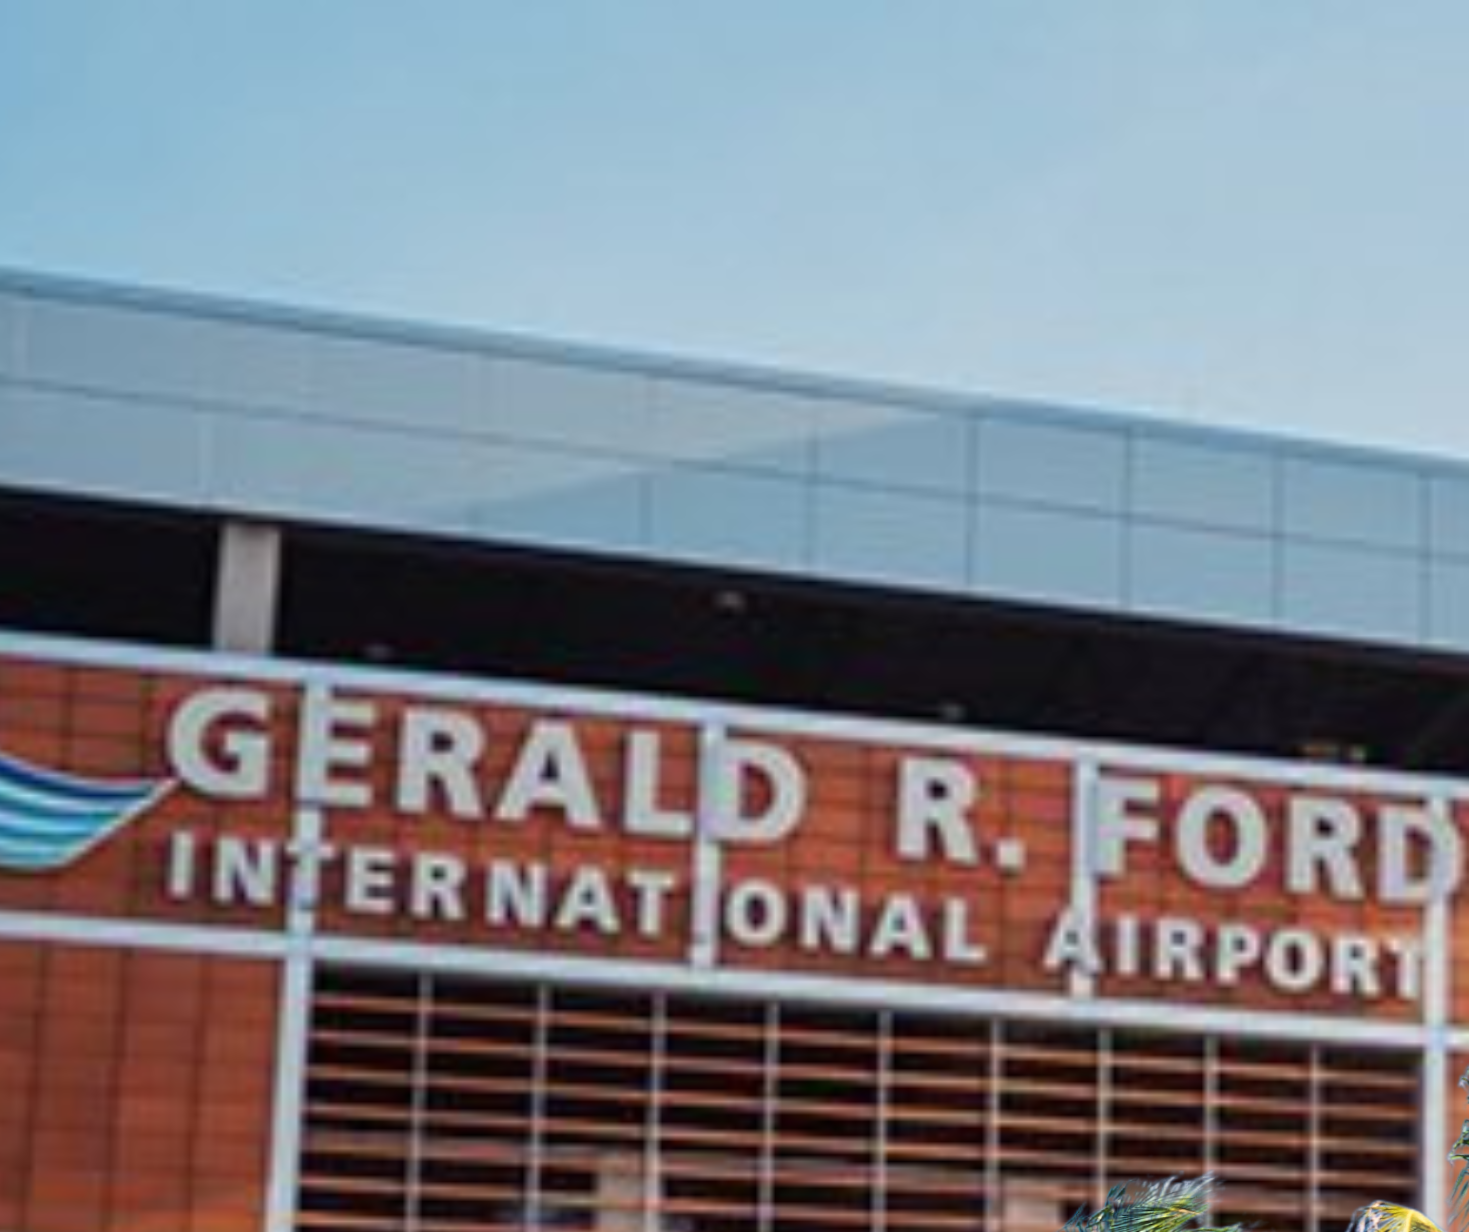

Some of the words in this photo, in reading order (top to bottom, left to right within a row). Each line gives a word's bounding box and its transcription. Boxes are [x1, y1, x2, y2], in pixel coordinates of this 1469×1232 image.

[170, 689, 804, 842] GERALD
[897, 756, 1024, 869] R.
[1098, 777, 1462, 901] FORD
[168, 832, 985, 962] INTERNATIONAL
[1044, 908, 1426, 999] AIRPORT
